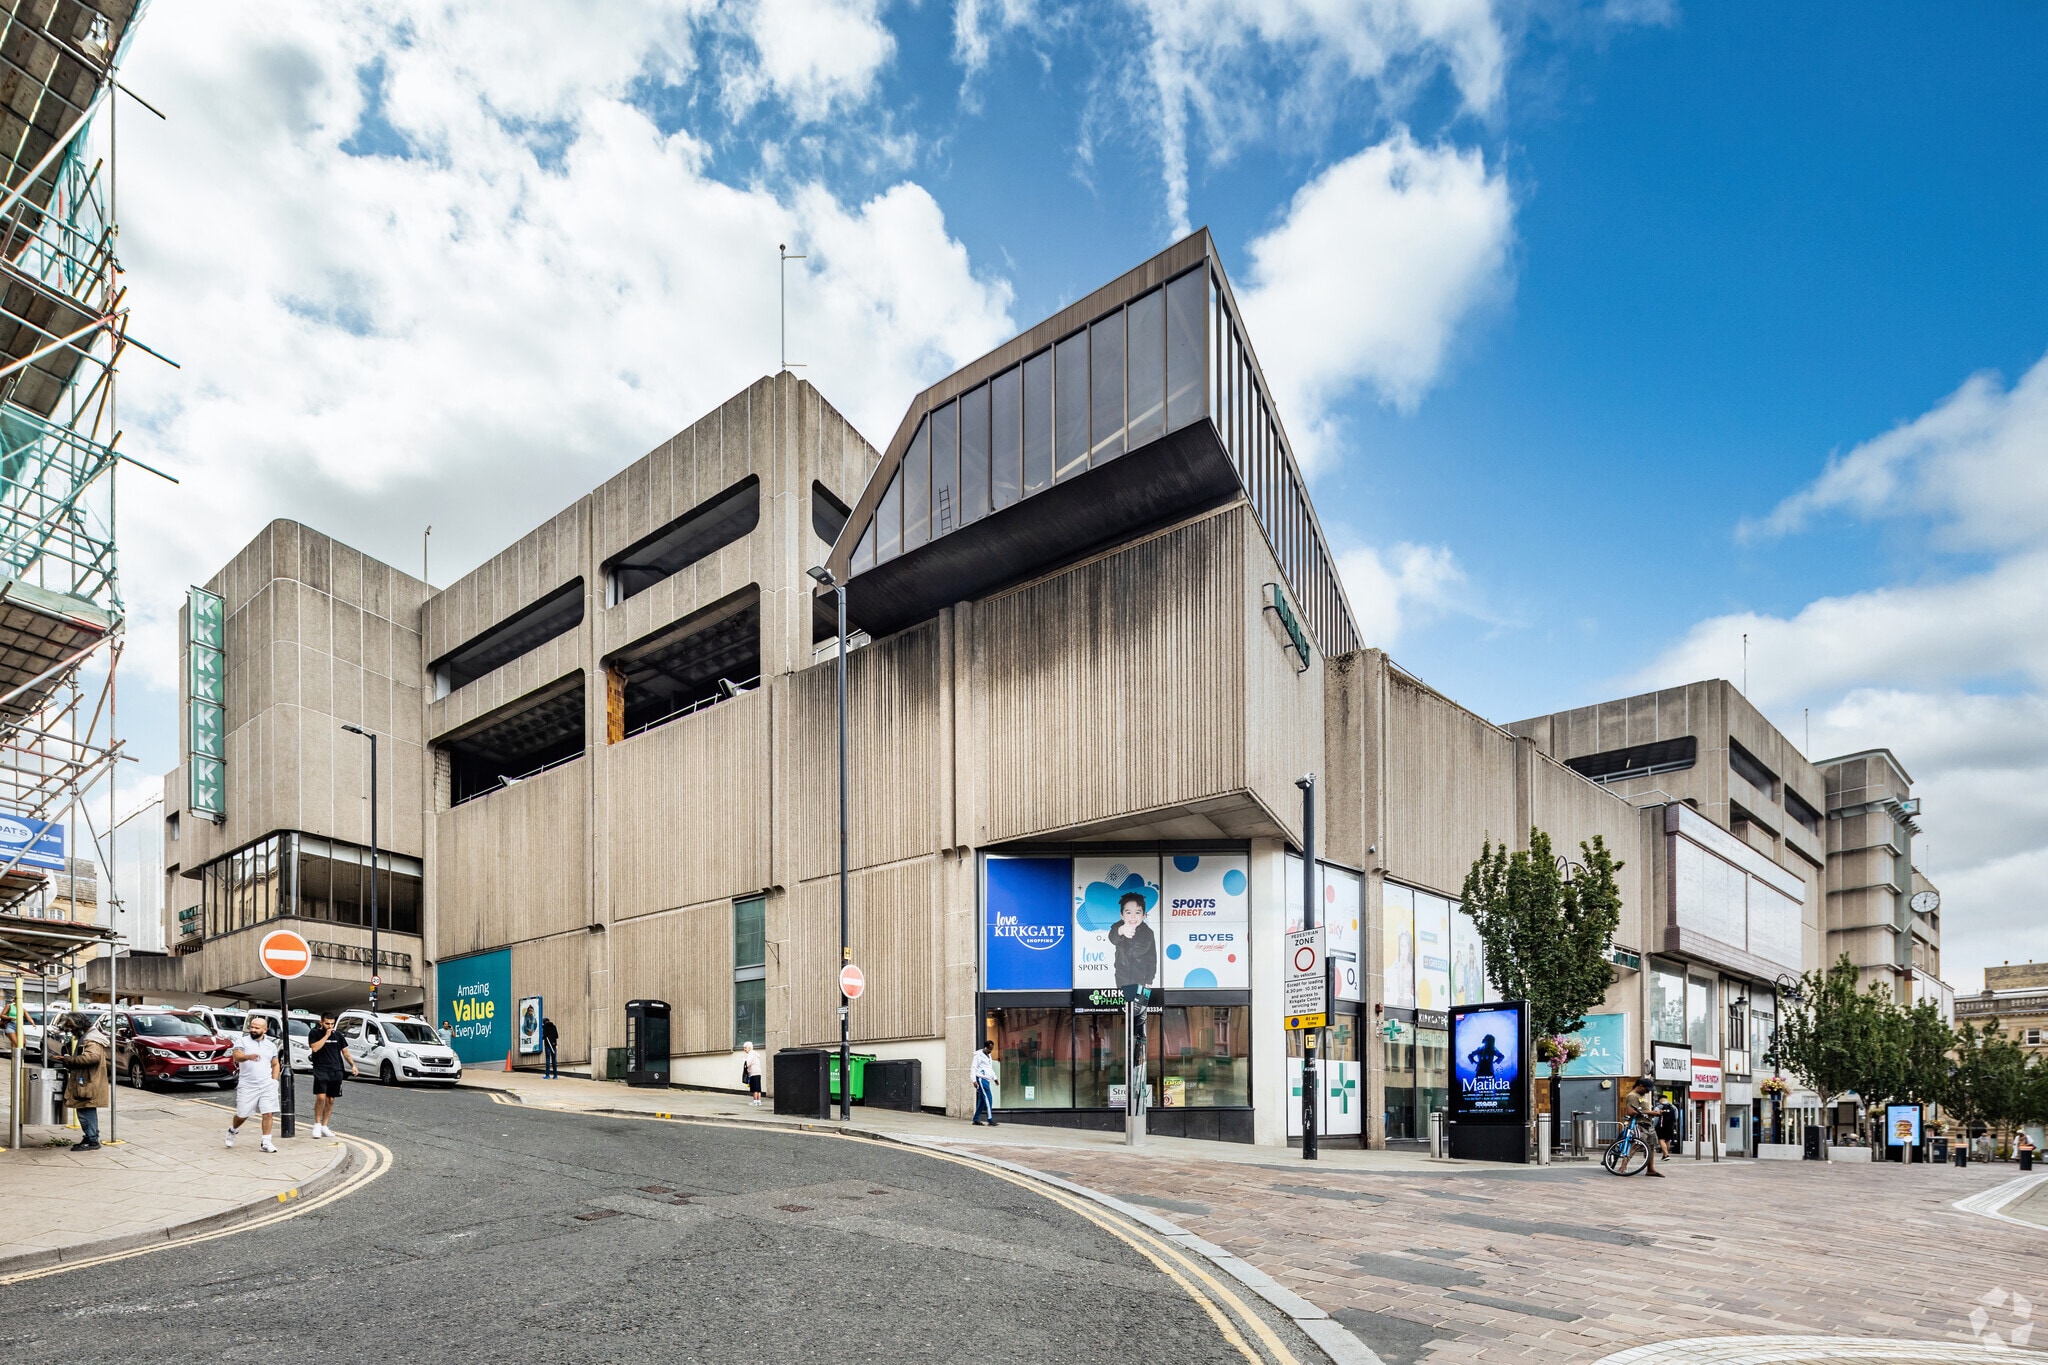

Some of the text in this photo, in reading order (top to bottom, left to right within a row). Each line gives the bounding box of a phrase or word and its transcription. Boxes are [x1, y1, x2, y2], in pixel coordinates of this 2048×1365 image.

[1172, 898, 1216, 909] SPORTS
[996, 911, 1018, 926] love
[994, 925, 1065, 937] KIRKGATE
[1291, 930, 1319, 939] PEDESTRIAN
[1328, 920, 1344, 940] sky
[1189, 933, 1234, 942] BOYES
[1294, 936, 1315, 947] ZONE
[1082, 947, 1105, 961] love
[457, 981, 490, 997] Amazing
[1101, 989, 1125, 998] KIRK
[452, 997, 495, 1022] Value
[455, 1021, 492, 1039] Every Day!
[1662, 1057, 1687, 1072] SHOETIQUE
[1462, 1077, 1511, 1092] Matilda
